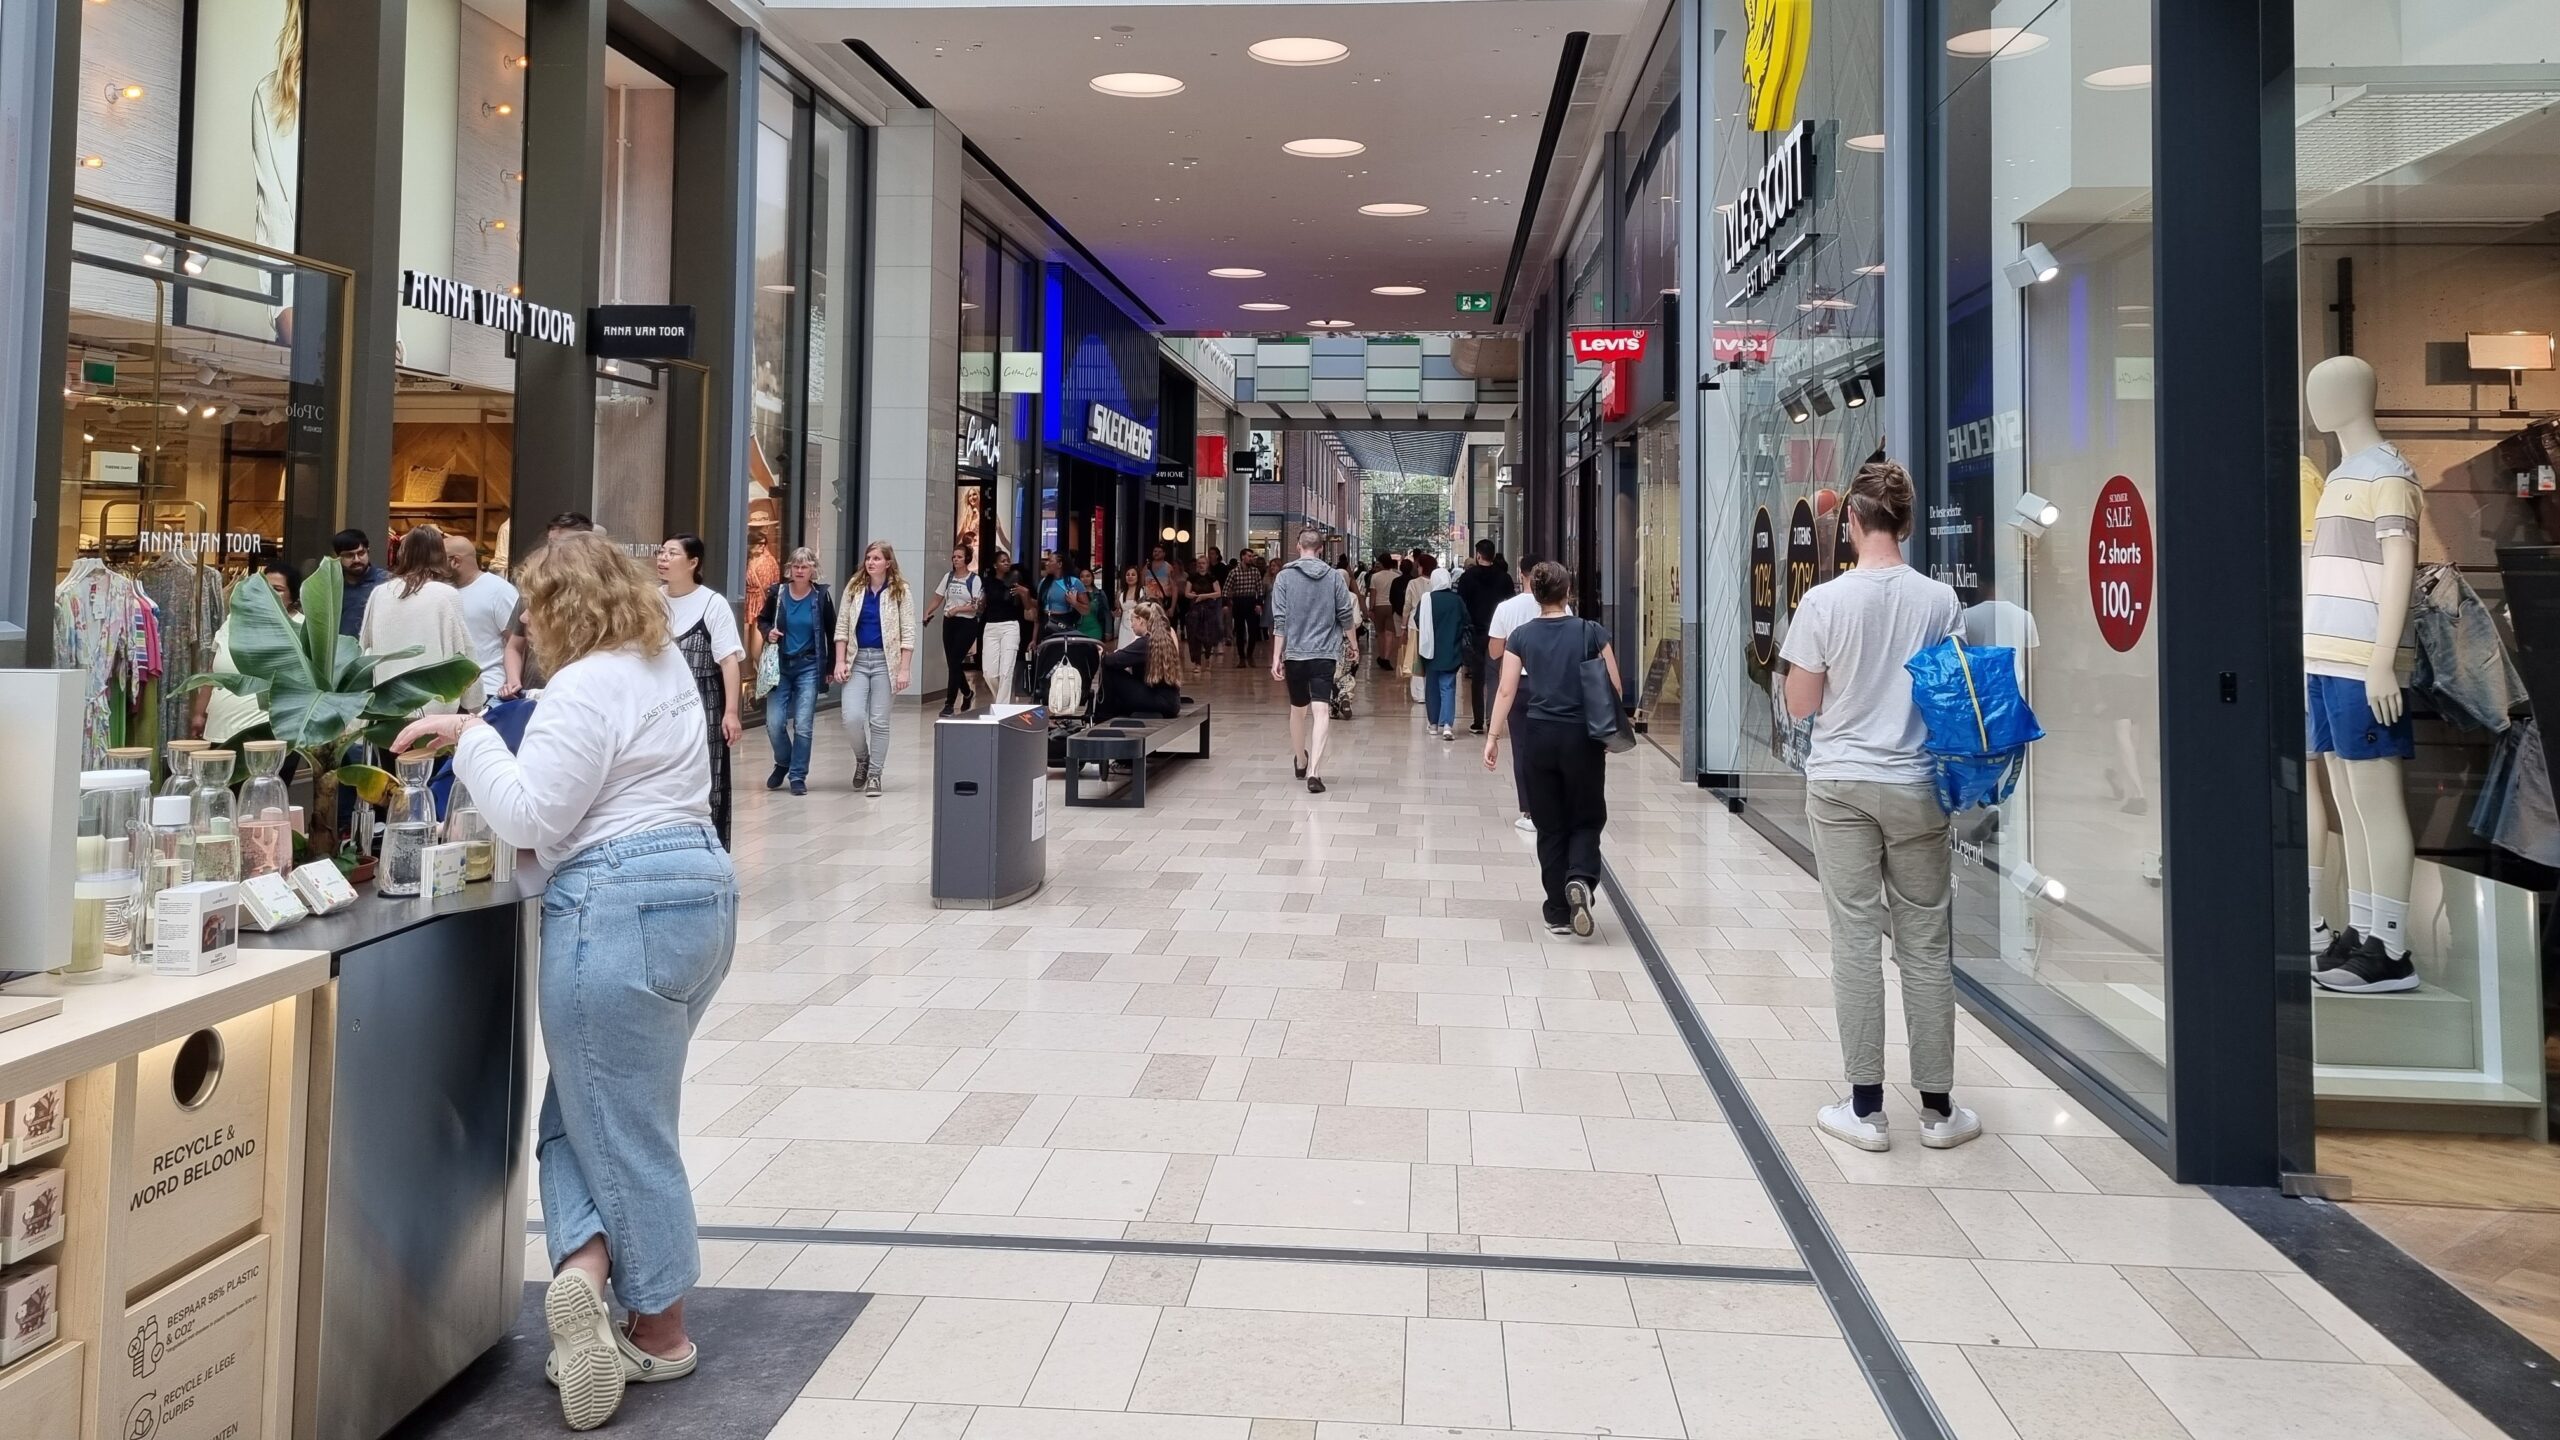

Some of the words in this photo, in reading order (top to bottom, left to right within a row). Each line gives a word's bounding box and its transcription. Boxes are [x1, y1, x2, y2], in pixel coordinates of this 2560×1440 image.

[1747, 265, 1758, 298] EST
[1761, 250, 1776, 286] 1874
[411, 270, 474, 321] ANNA
[480, 288, 522, 334] VAN
[528, 302, 574, 347] TOOR
[604, 326, 631, 336] ANNA
[635, 326, 655, 336] VAN
[659, 326, 685, 336] TOOR
[1092, 403, 1153, 460] SKECHERS
[2106, 506, 2132, 528] SALE
[2109, 492, 2128, 502] SUMMER
[140, 531, 183, 553] ANNA
[190, 532, 221, 553] VAN
[225, 533, 262, 553] TOOR
[2099, 540, 2106, 565] 2
[2108, 538, 2142, 565] shorts
[1754, 563, 1772, 608] 10%
[1956, 563, 1978, 588] Klein
[2101, 580, 2143, 626] 100,-
[1954, 828, 1983, 865] Legend
[153, 1128, 222, 1175] RECYCLE
[227, 1124, 235, 1140] &
[183, 1139, 255, 1186] BELOOND
[167, 1296, 207, 1329] BESPAAR
[227, 1265, 259, 1293] PLASTIC
[166, 1333, 173, 1346] &
[163, 1373, 203, 1407] RECYCLE
[204, 1366, 214, 1382] JE
[214, 1353, 236, 1375] LEGE
[162, 1396, 195, 1424] CUPJES
